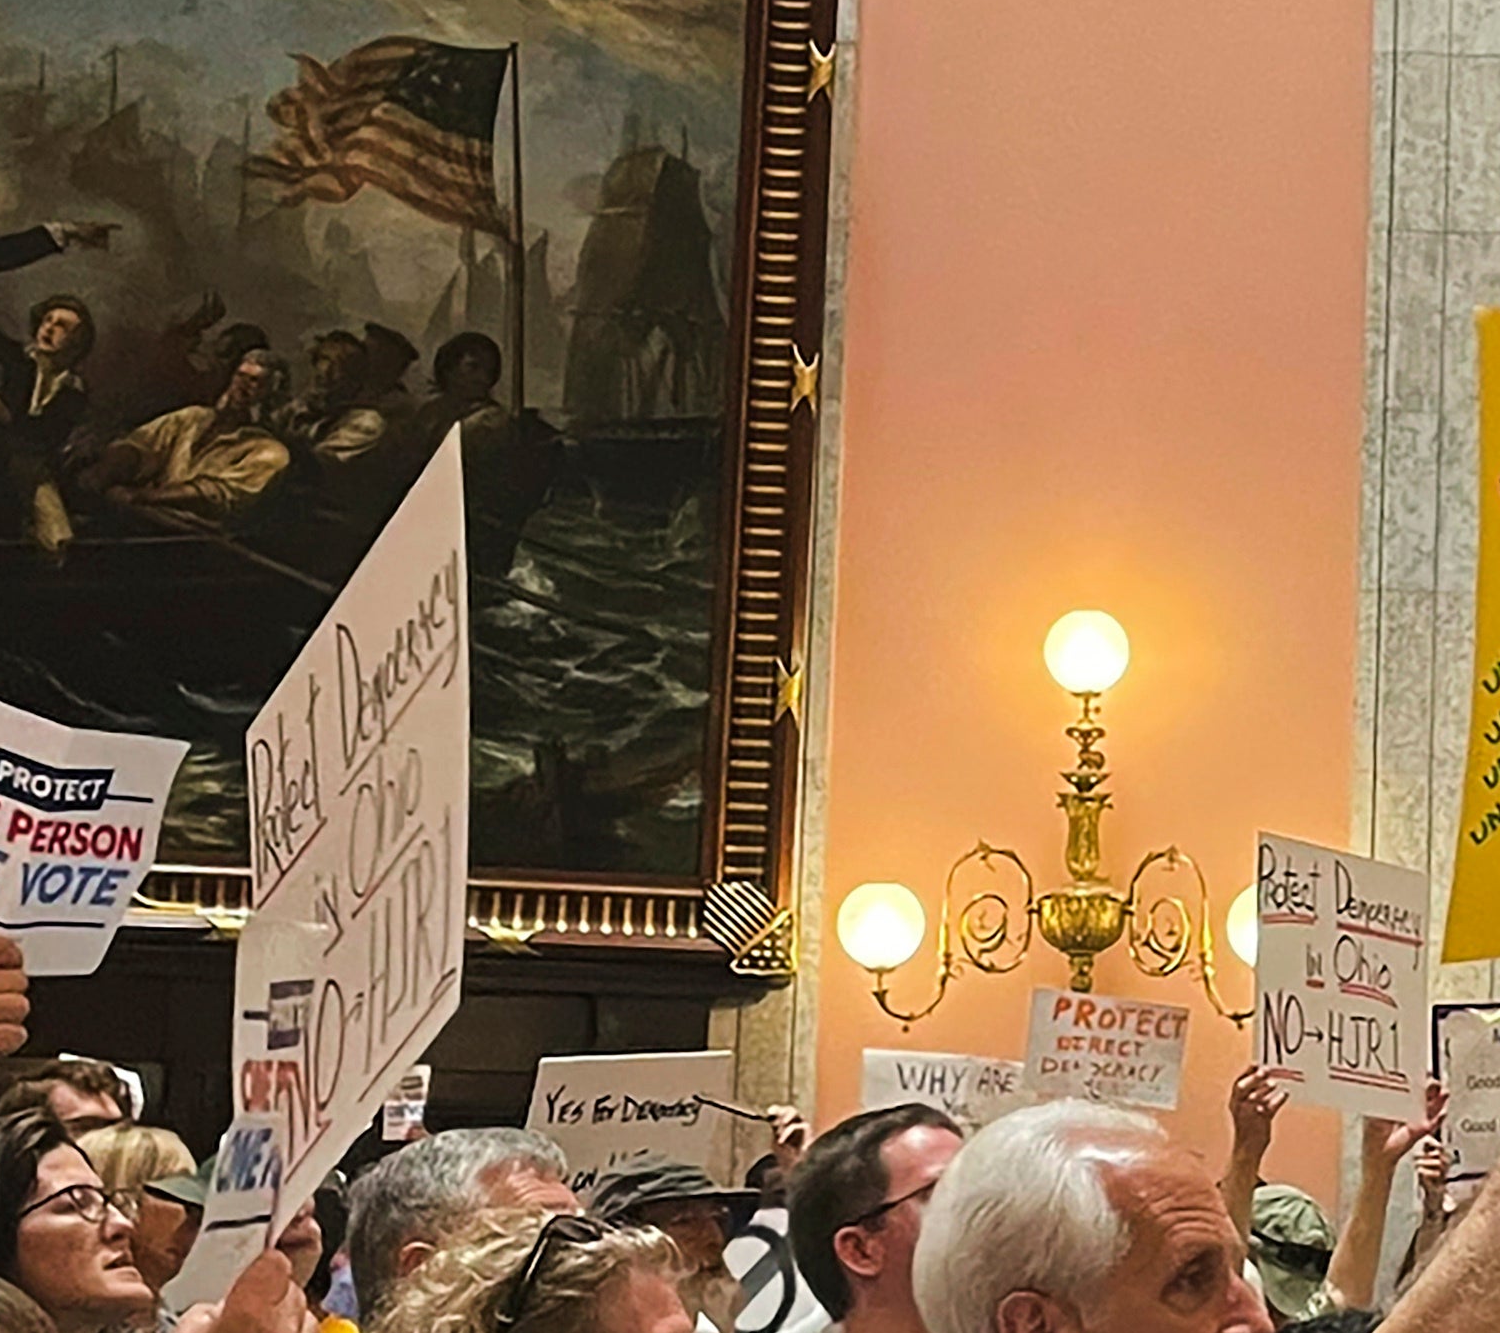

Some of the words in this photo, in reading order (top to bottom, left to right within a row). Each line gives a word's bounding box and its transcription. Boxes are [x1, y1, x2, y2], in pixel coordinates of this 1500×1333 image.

[7, 808, 143, 862] PERSON
[21, 863, 131, 907] VOTE
[1334, 934, 1392, 990] Ohio
[1053, 997, 1189, 1040] PROTECT
[1263, 989, 1304, 1065] NO
[1327, 1009, 1407, 1081] HJR1
[1056, 1035, 1145, 1057] DIRECT
[896, 1062, 967, 1095] WHY
[976, 1066, 1014, 1094] ARE
